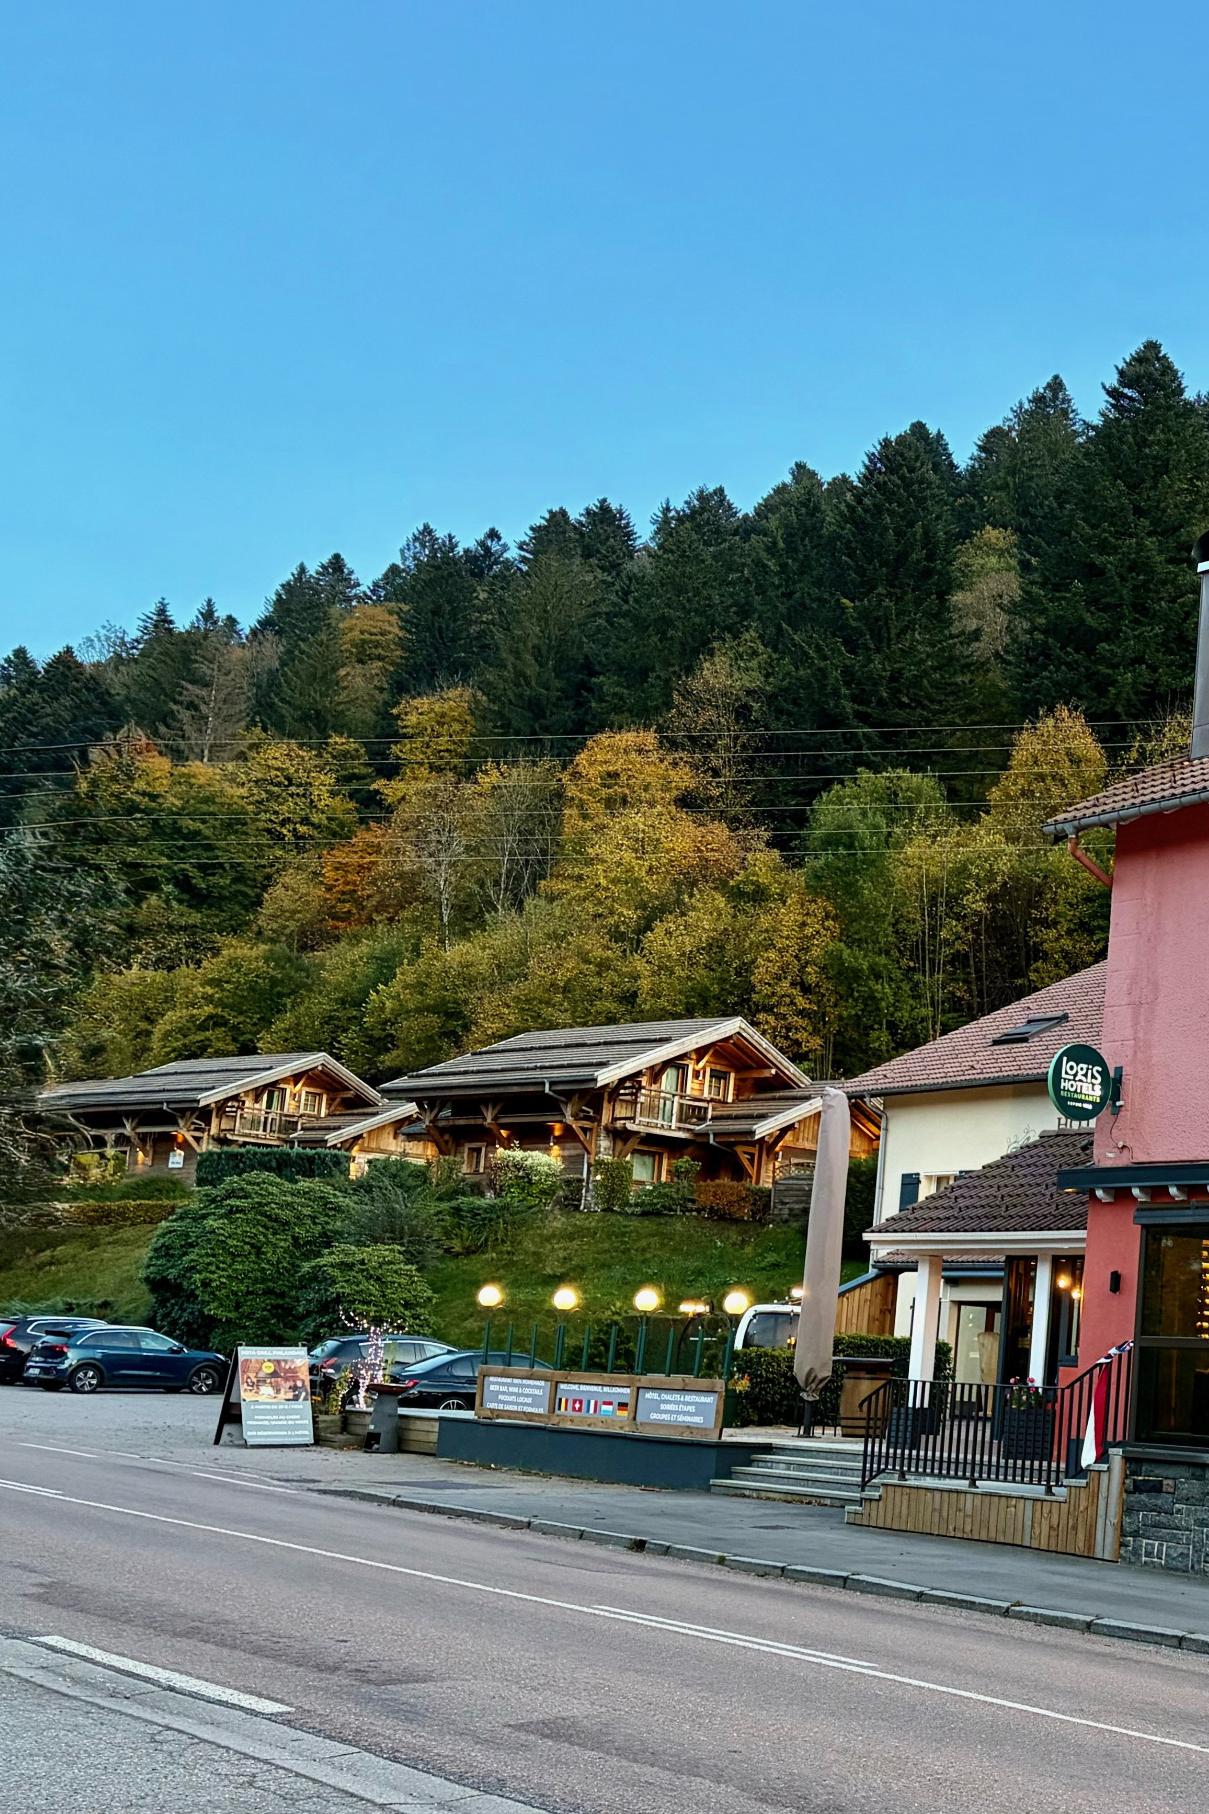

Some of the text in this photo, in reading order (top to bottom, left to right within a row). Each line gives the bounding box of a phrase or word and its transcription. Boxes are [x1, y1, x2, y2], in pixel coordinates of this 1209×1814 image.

[1060, 1079, 1102, 1097] HOTELS
[684, 1394, 714, 1404] RESTAURANT
[649, 1412, 670, 1421] GROUPES
[671, 1413, 676, 1421] ET
